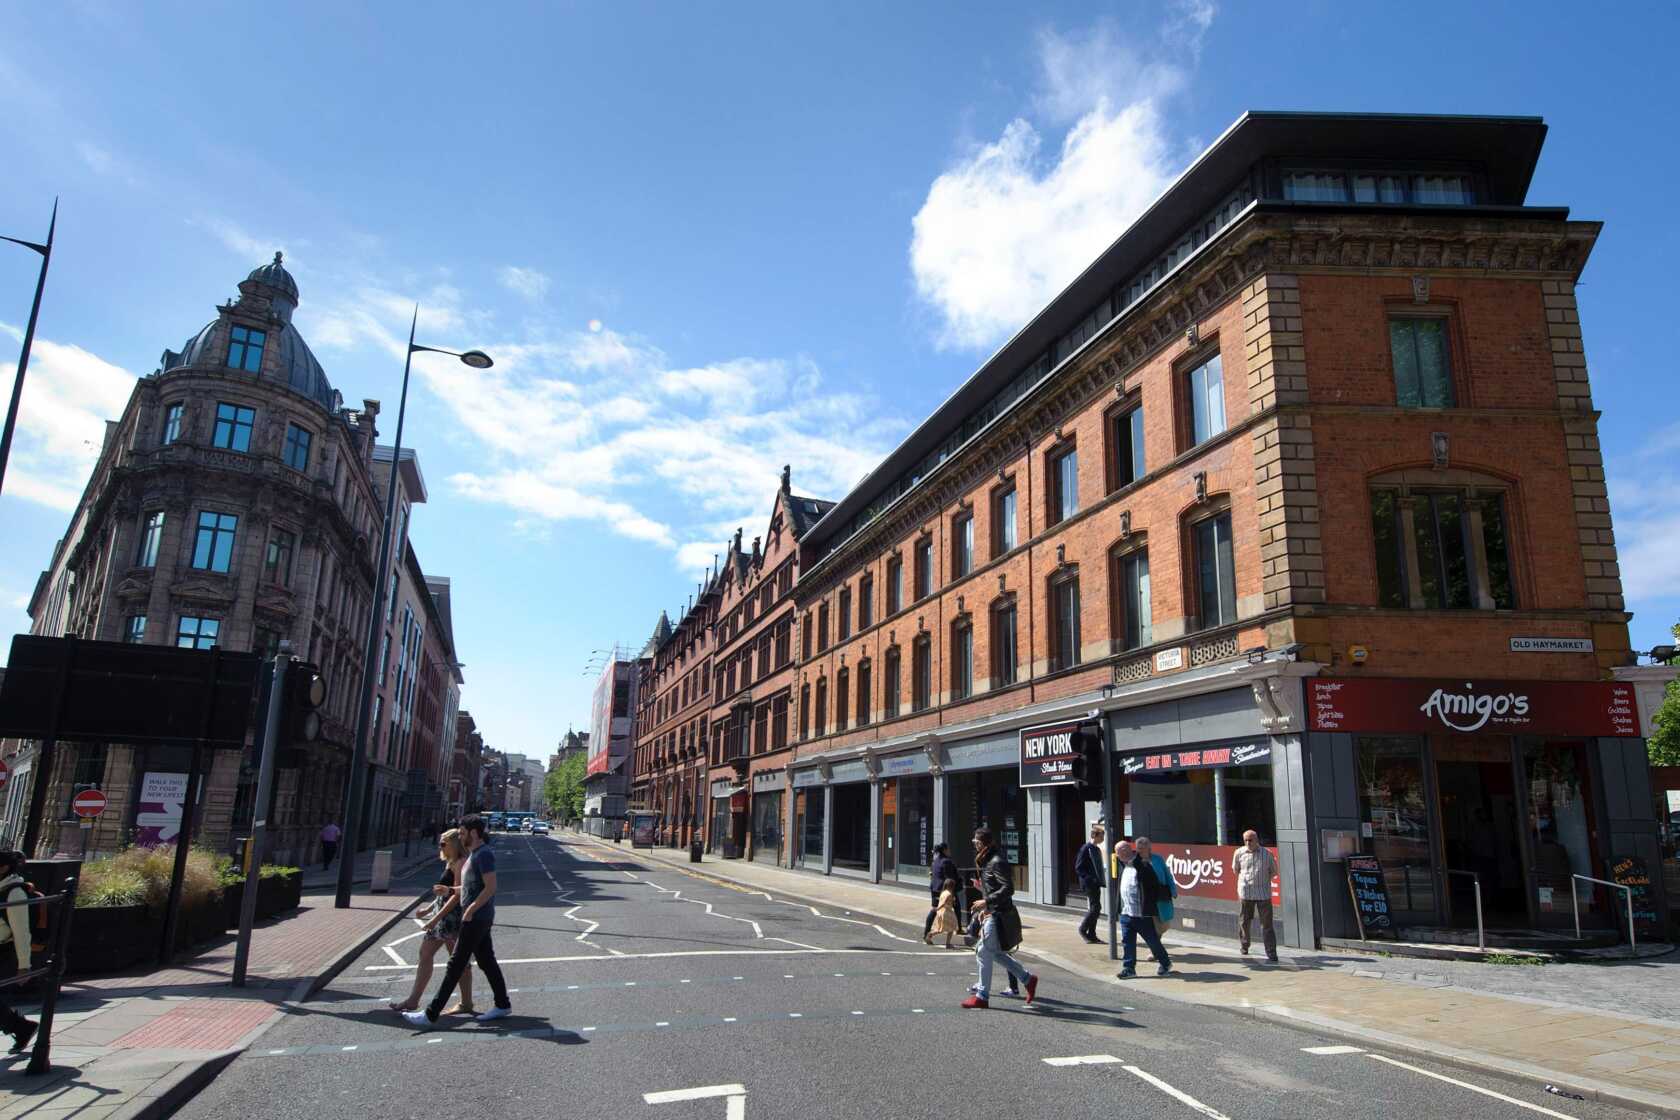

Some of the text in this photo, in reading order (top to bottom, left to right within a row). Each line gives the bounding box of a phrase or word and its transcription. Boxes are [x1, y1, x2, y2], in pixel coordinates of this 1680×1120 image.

[1533, 641, 1584, 649] HAYMARKET
[1158, 648, 1180, 660] VICTORIA
[1159, 658, 1177, 669] STREET
[1420, 683, 1529, 731] Amigo's
[1025, 737, 1045, 758] NEW
[1046, 732, 1072, 755] YORK
[1145, 756, 1160, 769] EAT
[1161, 754, 1172, 768] IN
[1178, 751, 1200, 766] TAKE
[1202, 748, 1231, 764] AWAY
[1041, 760, 1073, 773] Steak Hous
